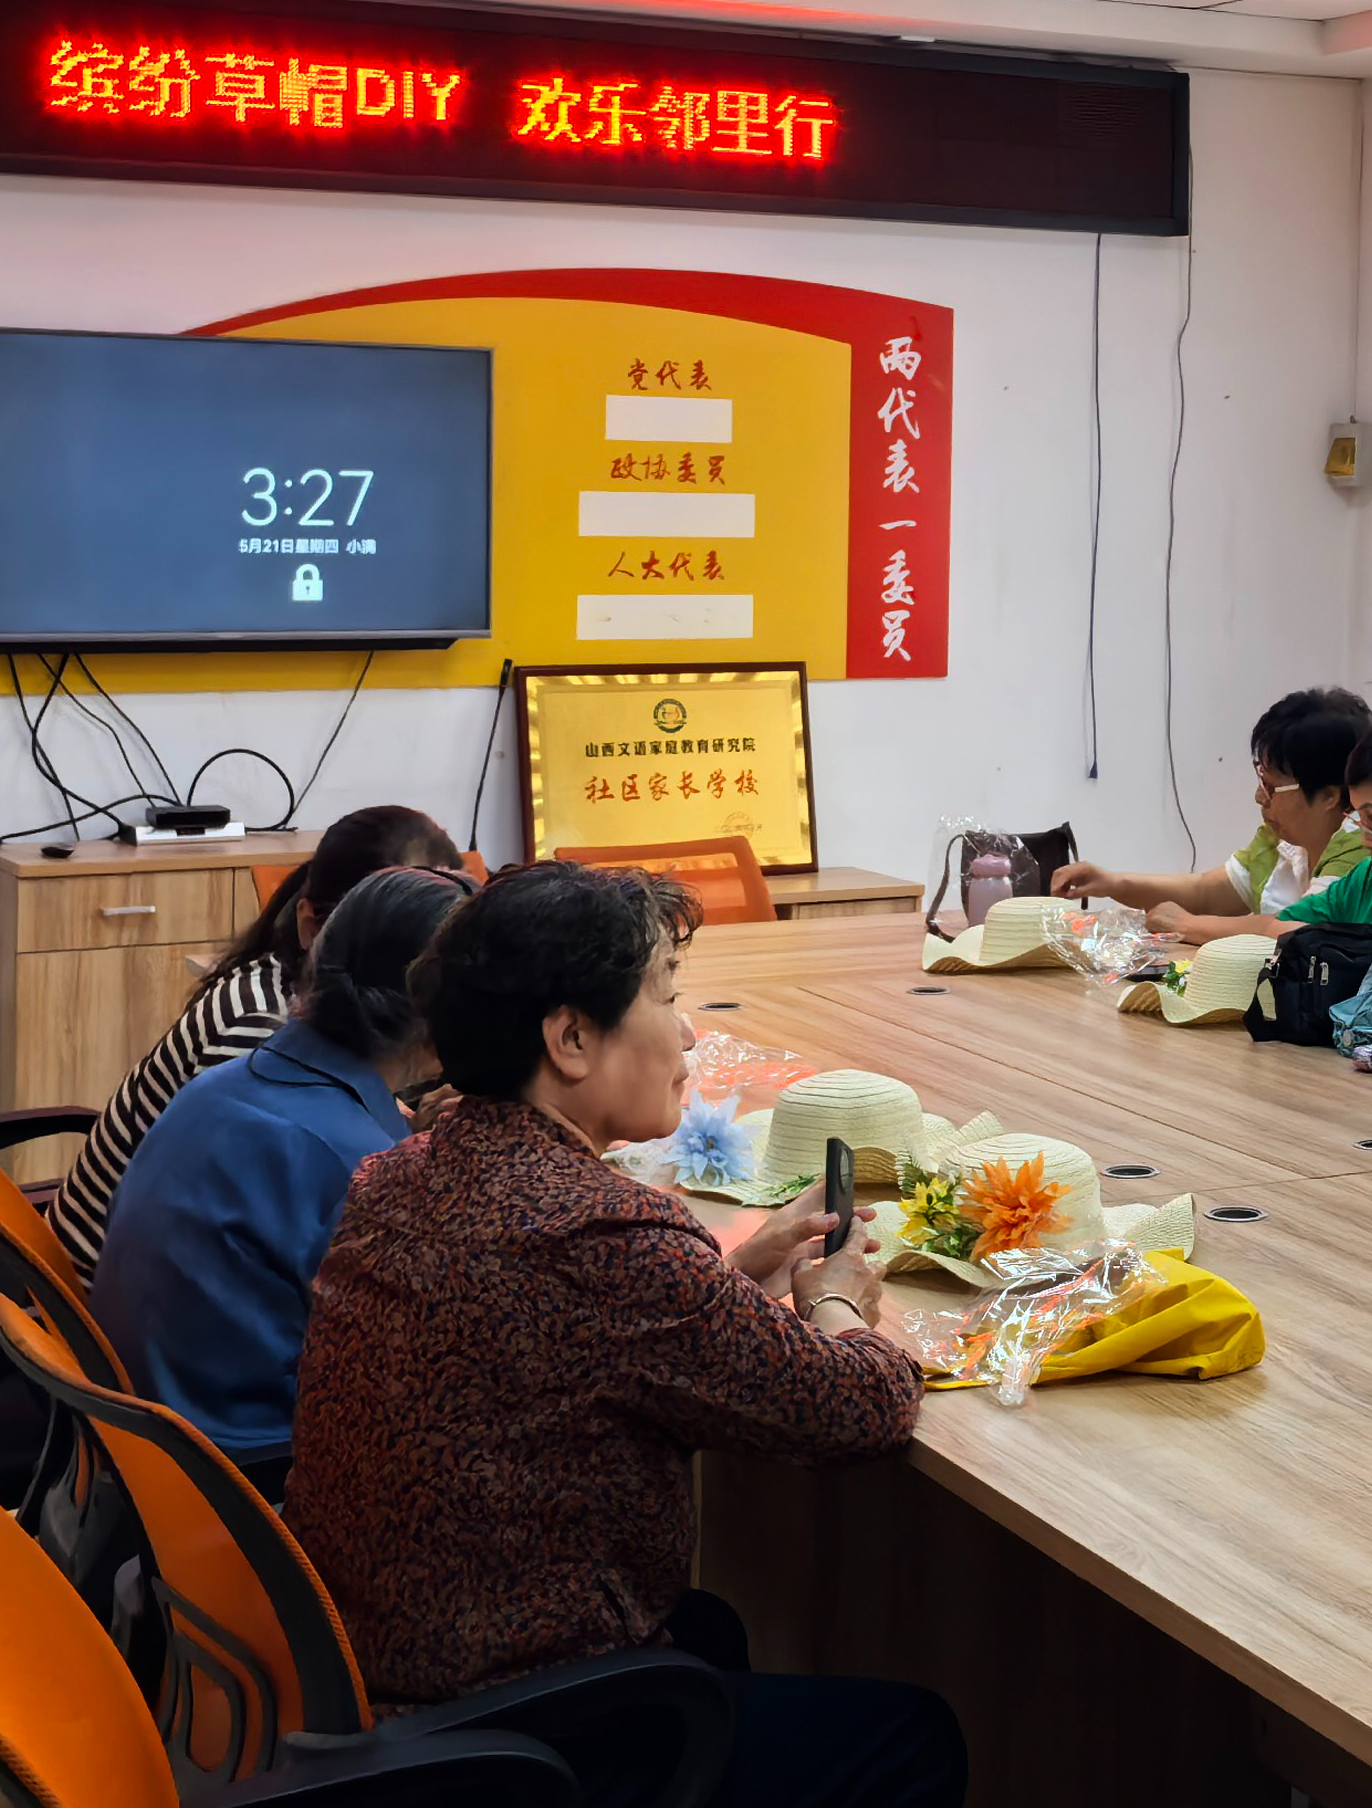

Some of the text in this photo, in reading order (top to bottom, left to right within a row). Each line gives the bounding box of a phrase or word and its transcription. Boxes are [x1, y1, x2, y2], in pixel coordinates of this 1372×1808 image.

[49, 40, 834, 159] 缤纷草帽DIY 欢乐邻里行
[627, 358, 712, 391] 党代表
[610, 452, 726, 485] 政协委员
[241, 467, 375, 527] 3:27
[877, 336, 922, 661] 两代表一委员
[238, 537, 377, 555] 5月21日星期四 小满
[607, 550, 725, 581] 人大代表
[585, 737, 757, 758] 山西文语家庭教育研究院
[584, 769, 760, 804] 社区家长学校
